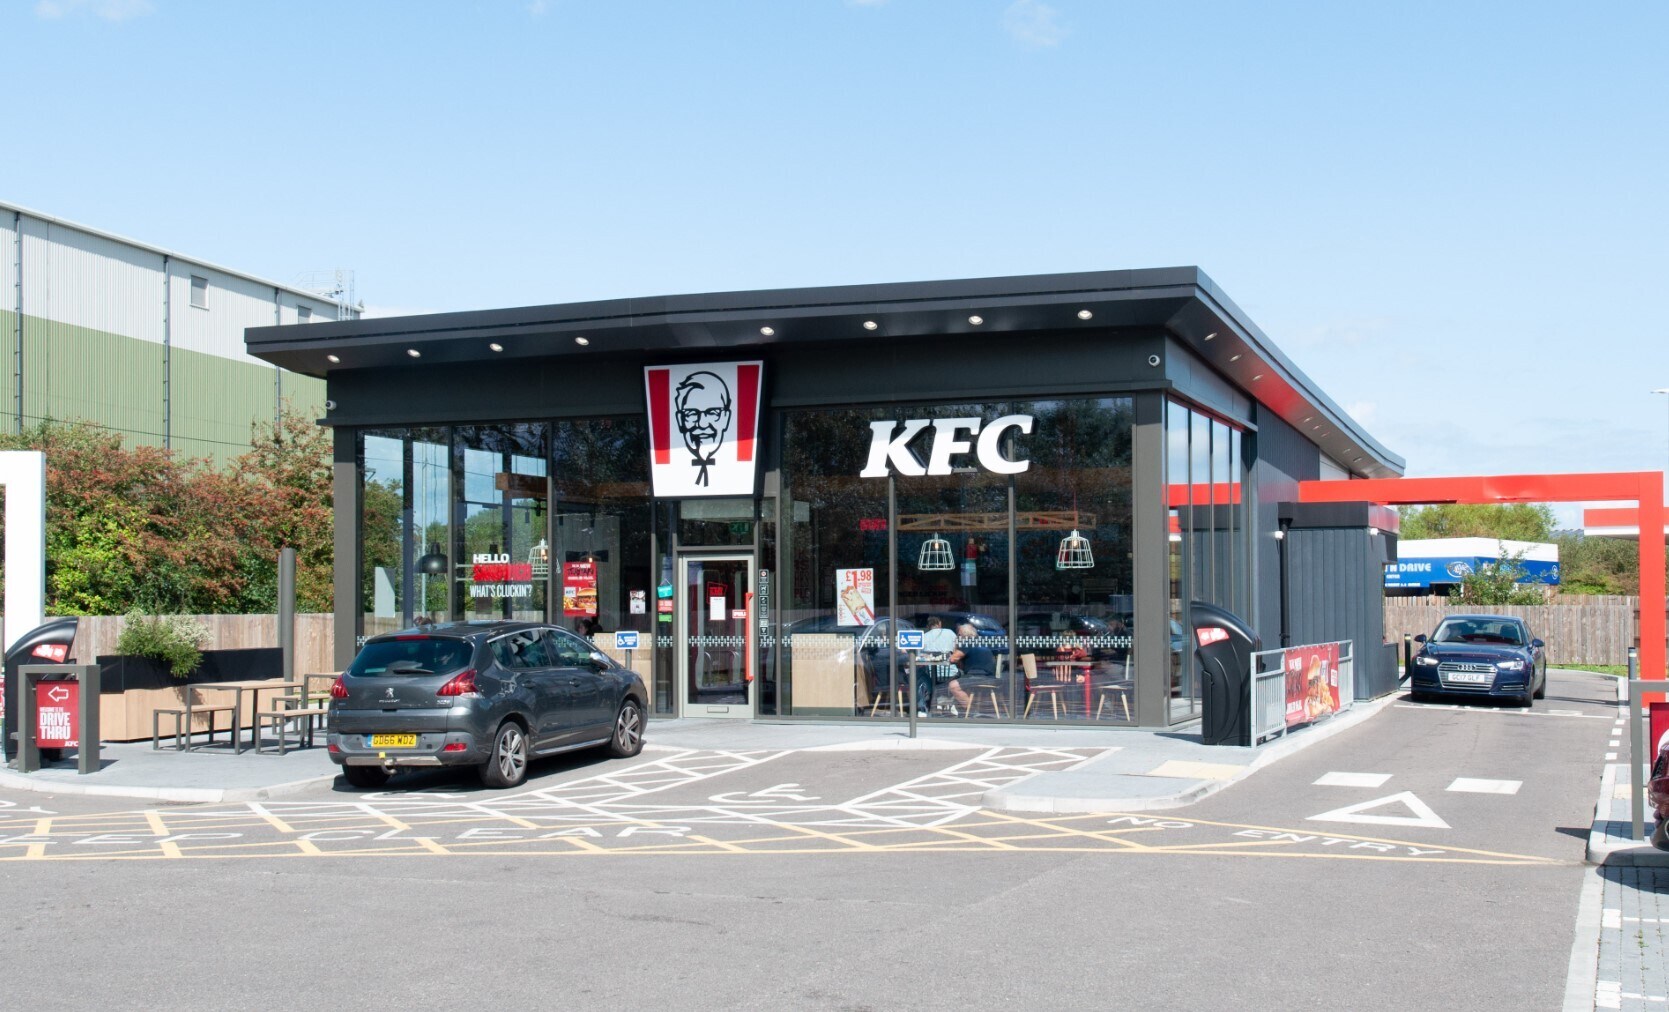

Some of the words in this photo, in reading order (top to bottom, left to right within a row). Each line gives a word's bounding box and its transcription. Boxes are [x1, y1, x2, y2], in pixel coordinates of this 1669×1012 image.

[860, 414, 1033, 478] KFC
[473, 553, 510, 564] HELLO
[1399, 563, 1432, 572] DRIVE
[846, 570, 872, 589] £1.98
[470, 584, 496, 598] WHAT'S
[496, 584, 533, 598] CLUCKIN'?
[40, 712, 71, 726] DRIVE
[40, 726, 71, 740] THRU
[0, 832, 244, 845] EEP
[298, 826, 692, 842] CLEAR
[1106, 816, 1194, 830] NO
[1232, 829, 1446, 856] ENTRY
